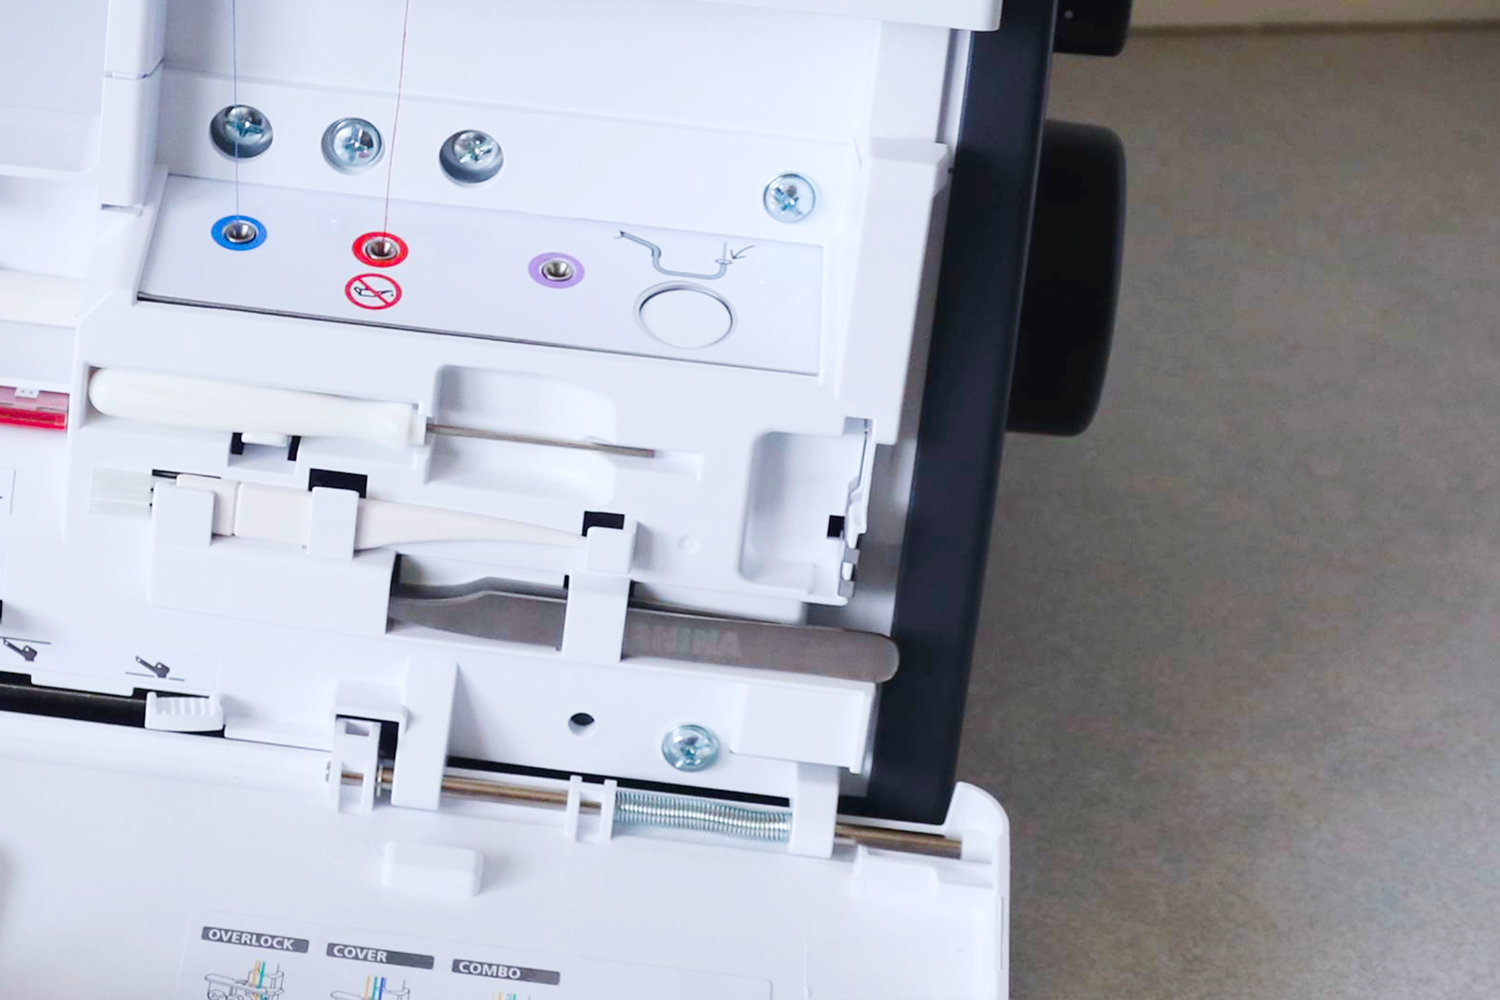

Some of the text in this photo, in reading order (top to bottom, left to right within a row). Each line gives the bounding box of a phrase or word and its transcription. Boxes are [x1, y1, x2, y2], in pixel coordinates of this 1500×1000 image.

[208, 929, 294, 950] OVERLOCK
[333, 946, 387, 962] COVER
[459, 962, 521, 979] COMBO
